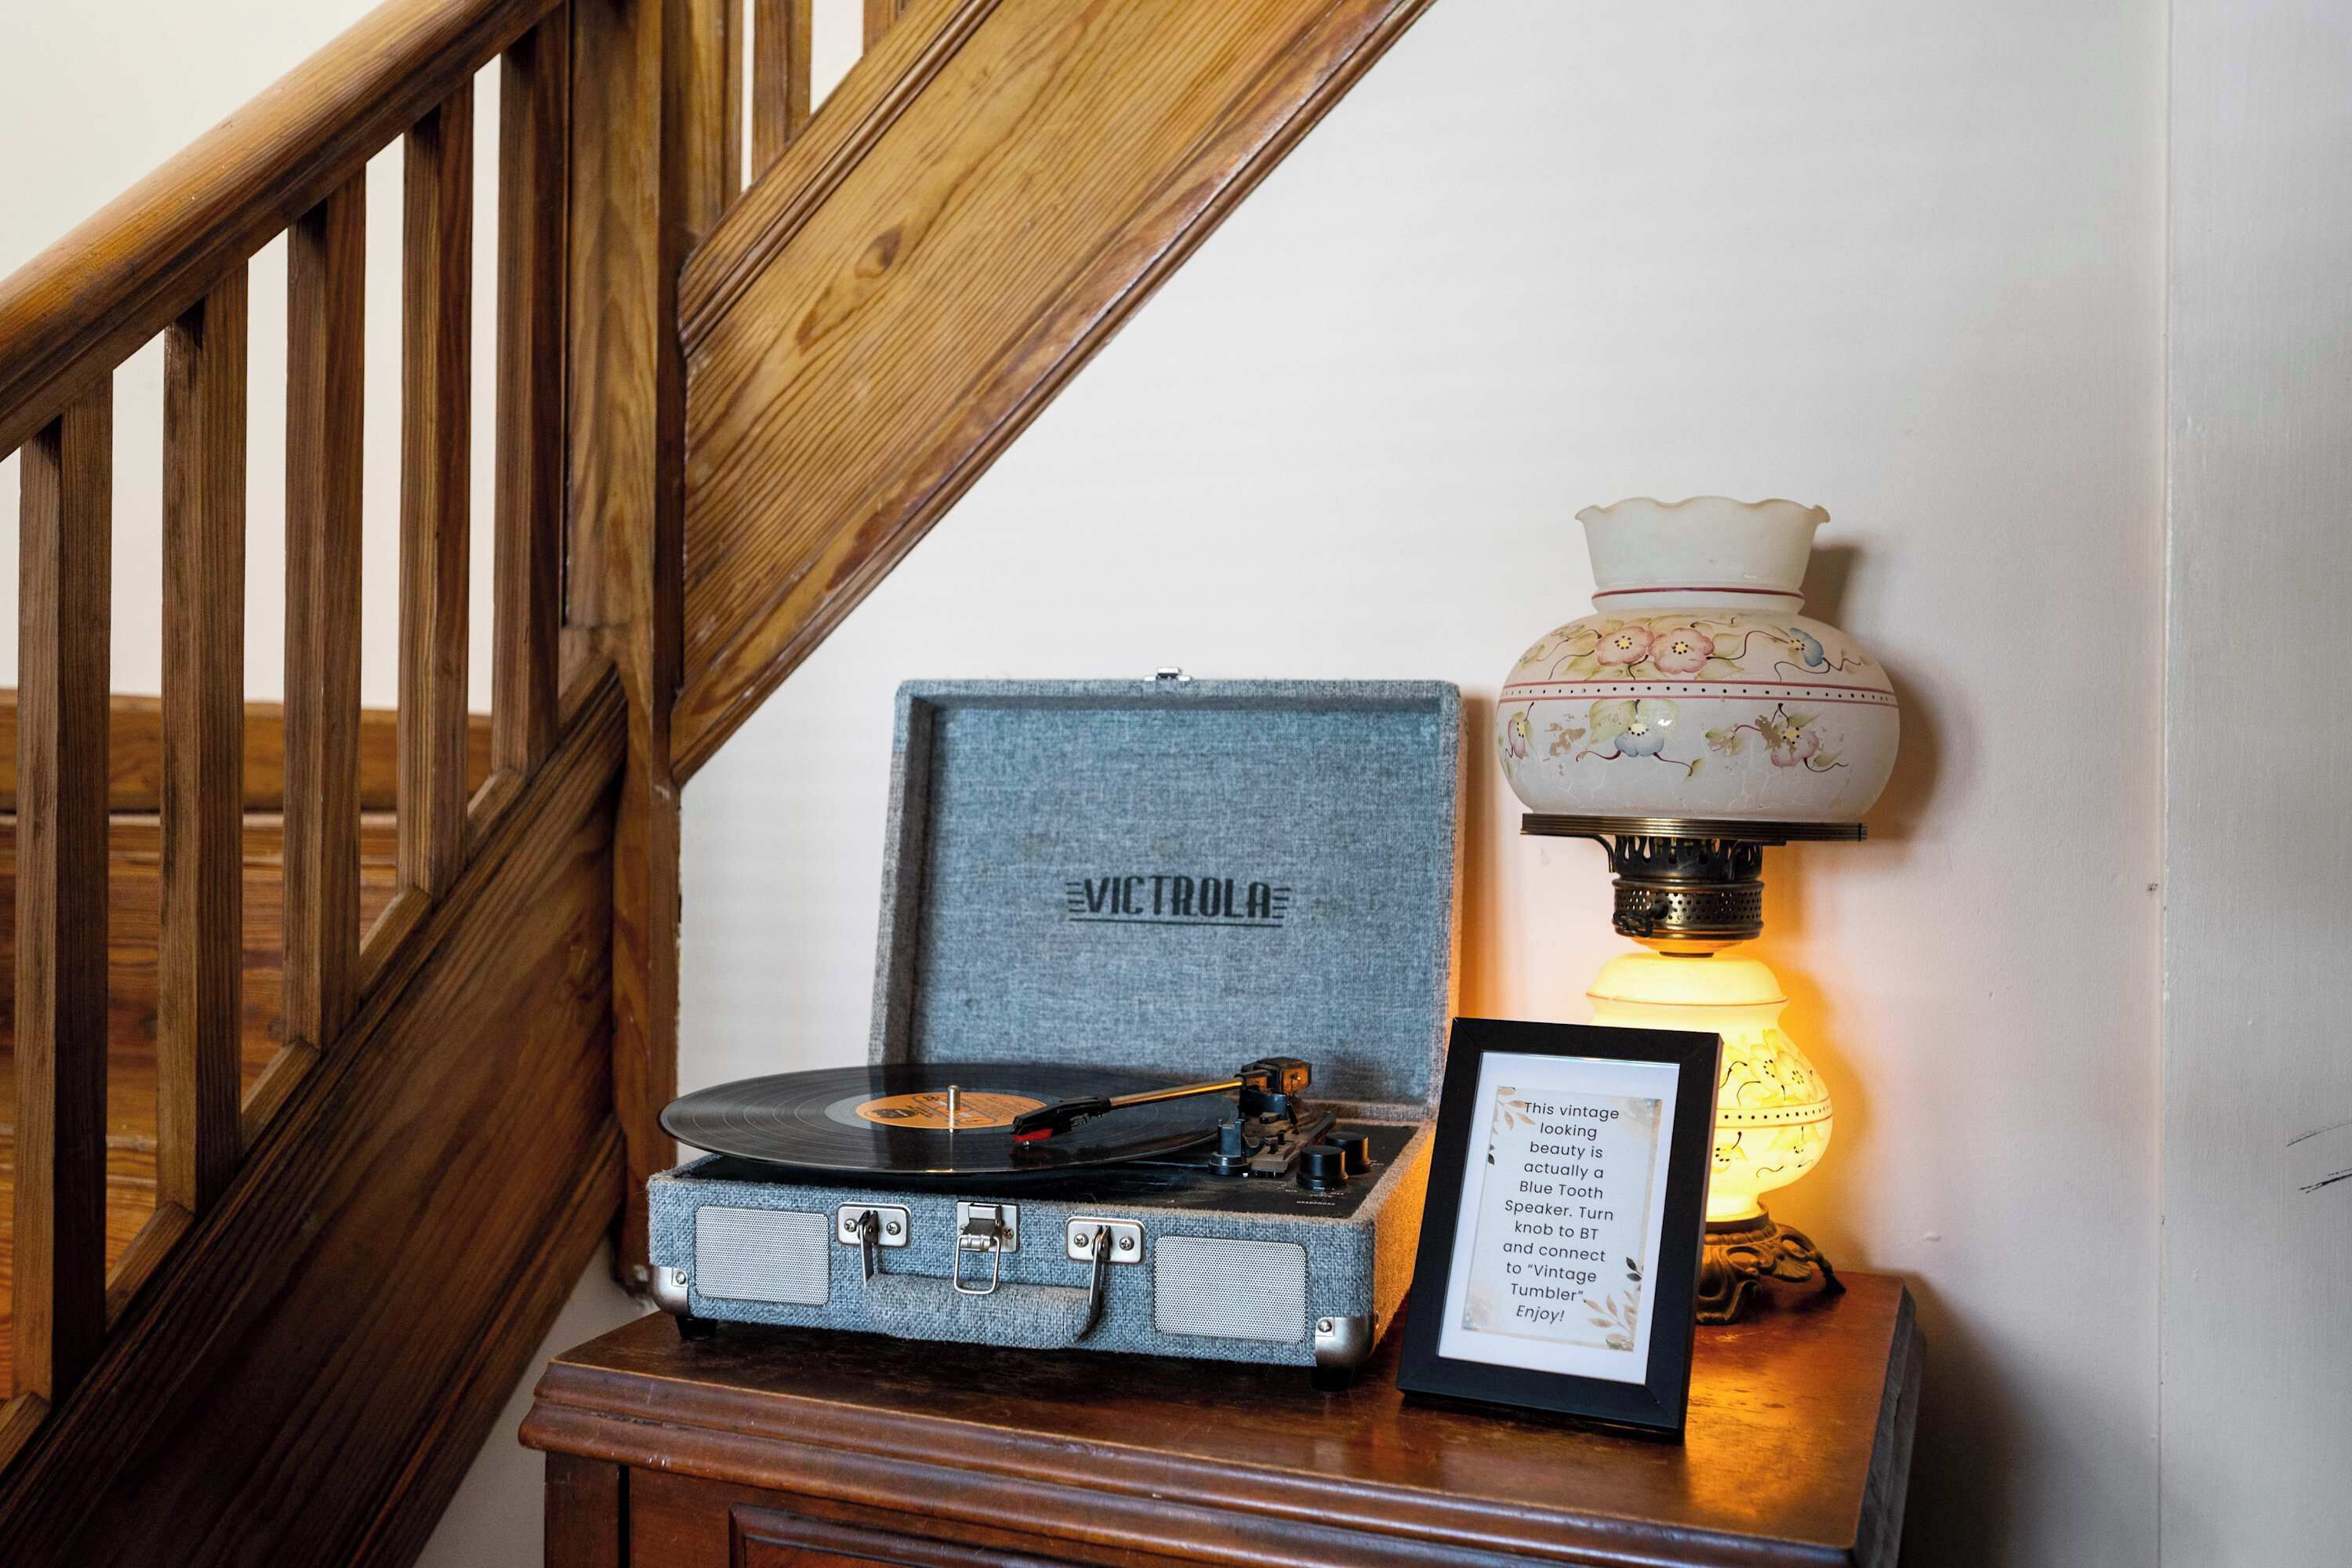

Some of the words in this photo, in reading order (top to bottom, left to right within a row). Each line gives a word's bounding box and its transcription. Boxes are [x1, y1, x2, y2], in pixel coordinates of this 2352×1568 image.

[1084, 876, 1271, 918] VICTROLA
[1525, 1102, 1555, 1115] This
[1559, 1105, 1620, 1122] vintage
[1540, 1122, 1597, 1141] looking
[1530, 1141, 1585, 1160] beauty
[1591, 1146, 1603, 1158] is
[1524, 1163, 1588, 1180] actually
[1594, 1169, 1603, 1178] a
[1520, 1181, 1553, 1195] Blue
[1559, 1185, 1603, 1200] Tooth
[1505, 1200, 1573, 1218] Speaker.
[1579, 1207, 1613, 1221] Turn
[1515, 1221, 1553, 1236] knob
[1559, 1226, 1574, 1238] to
[1580, 1228, 1599, 1240] BT
[1503, 1243, 1534, 1254] and
[1539, 1247, 1606, 1262] connect
[1507, 1262, 1522, 1274] to
[1527, 1264, 1597, 1284] “Vintage
[1512, 1283, 1584, 1301] Tumbler”
[1516, 1305, 1565, 1323] Enjoy!
